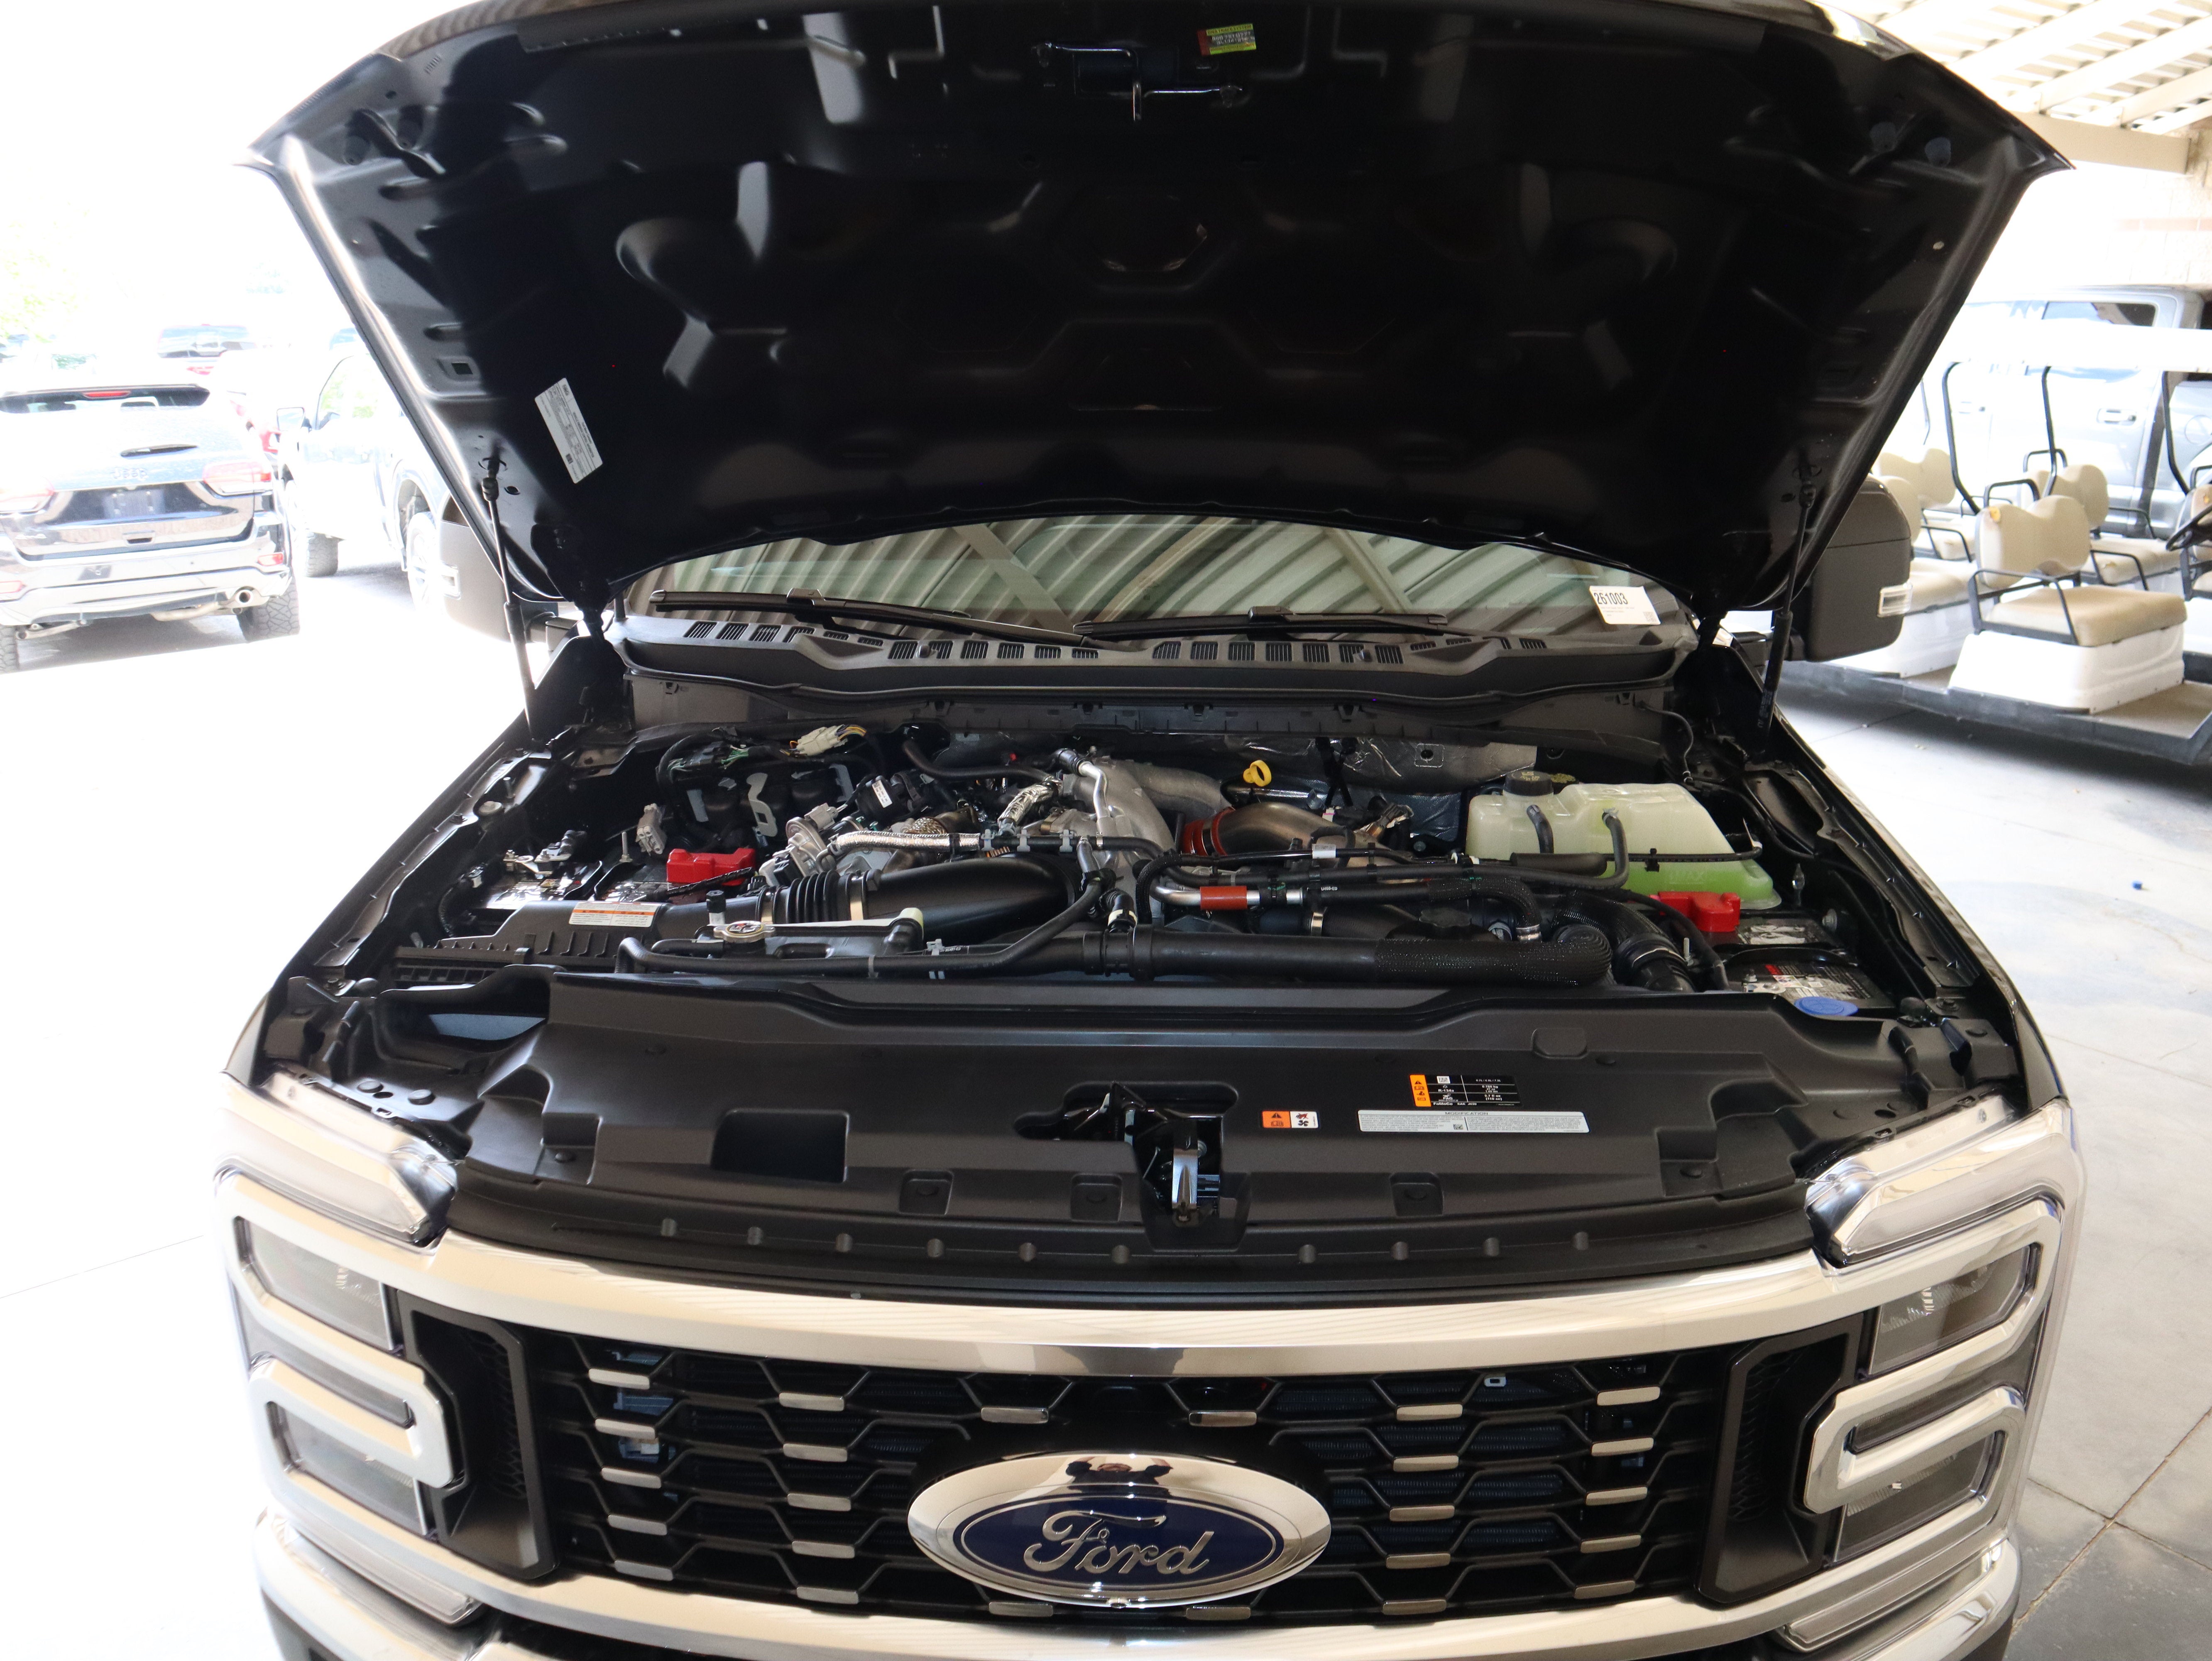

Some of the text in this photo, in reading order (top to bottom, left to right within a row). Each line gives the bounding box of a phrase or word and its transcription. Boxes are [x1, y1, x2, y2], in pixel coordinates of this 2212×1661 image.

[110, 467, 147, 480] Jeep
[1593, 592, 1628, 605] 261003
[1023, 1510, 1215, 1575] Ford
